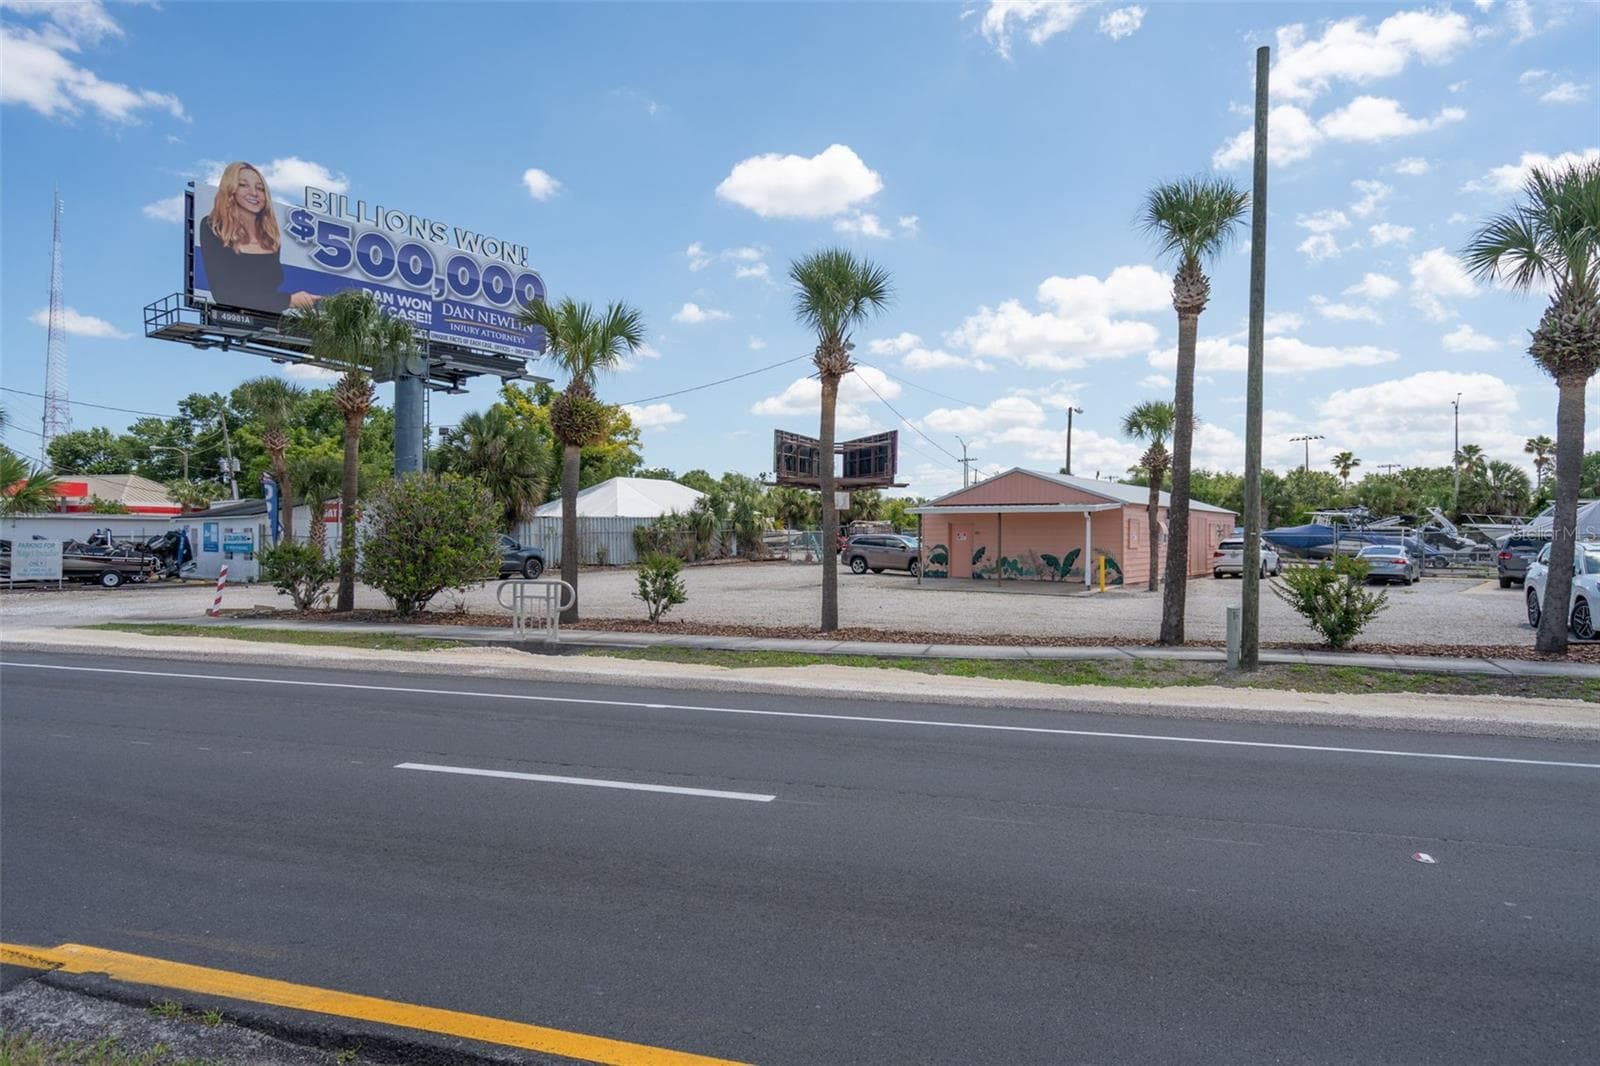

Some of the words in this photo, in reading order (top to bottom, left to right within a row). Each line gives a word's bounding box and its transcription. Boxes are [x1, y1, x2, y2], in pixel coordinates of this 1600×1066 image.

[305, 186, 449, 246] BILLIONS
[454, 227, 529, 268] WON!
[288, 208, 547, 310] $500,000
[396, 294, 432, 313] WON
[441, 303, 474, 320] DAN
[387, 306, 432, 325] CASE!!
[450, 323, 479, 335] INJURY
[481, 329, 526, 344] ATTORNEYS
